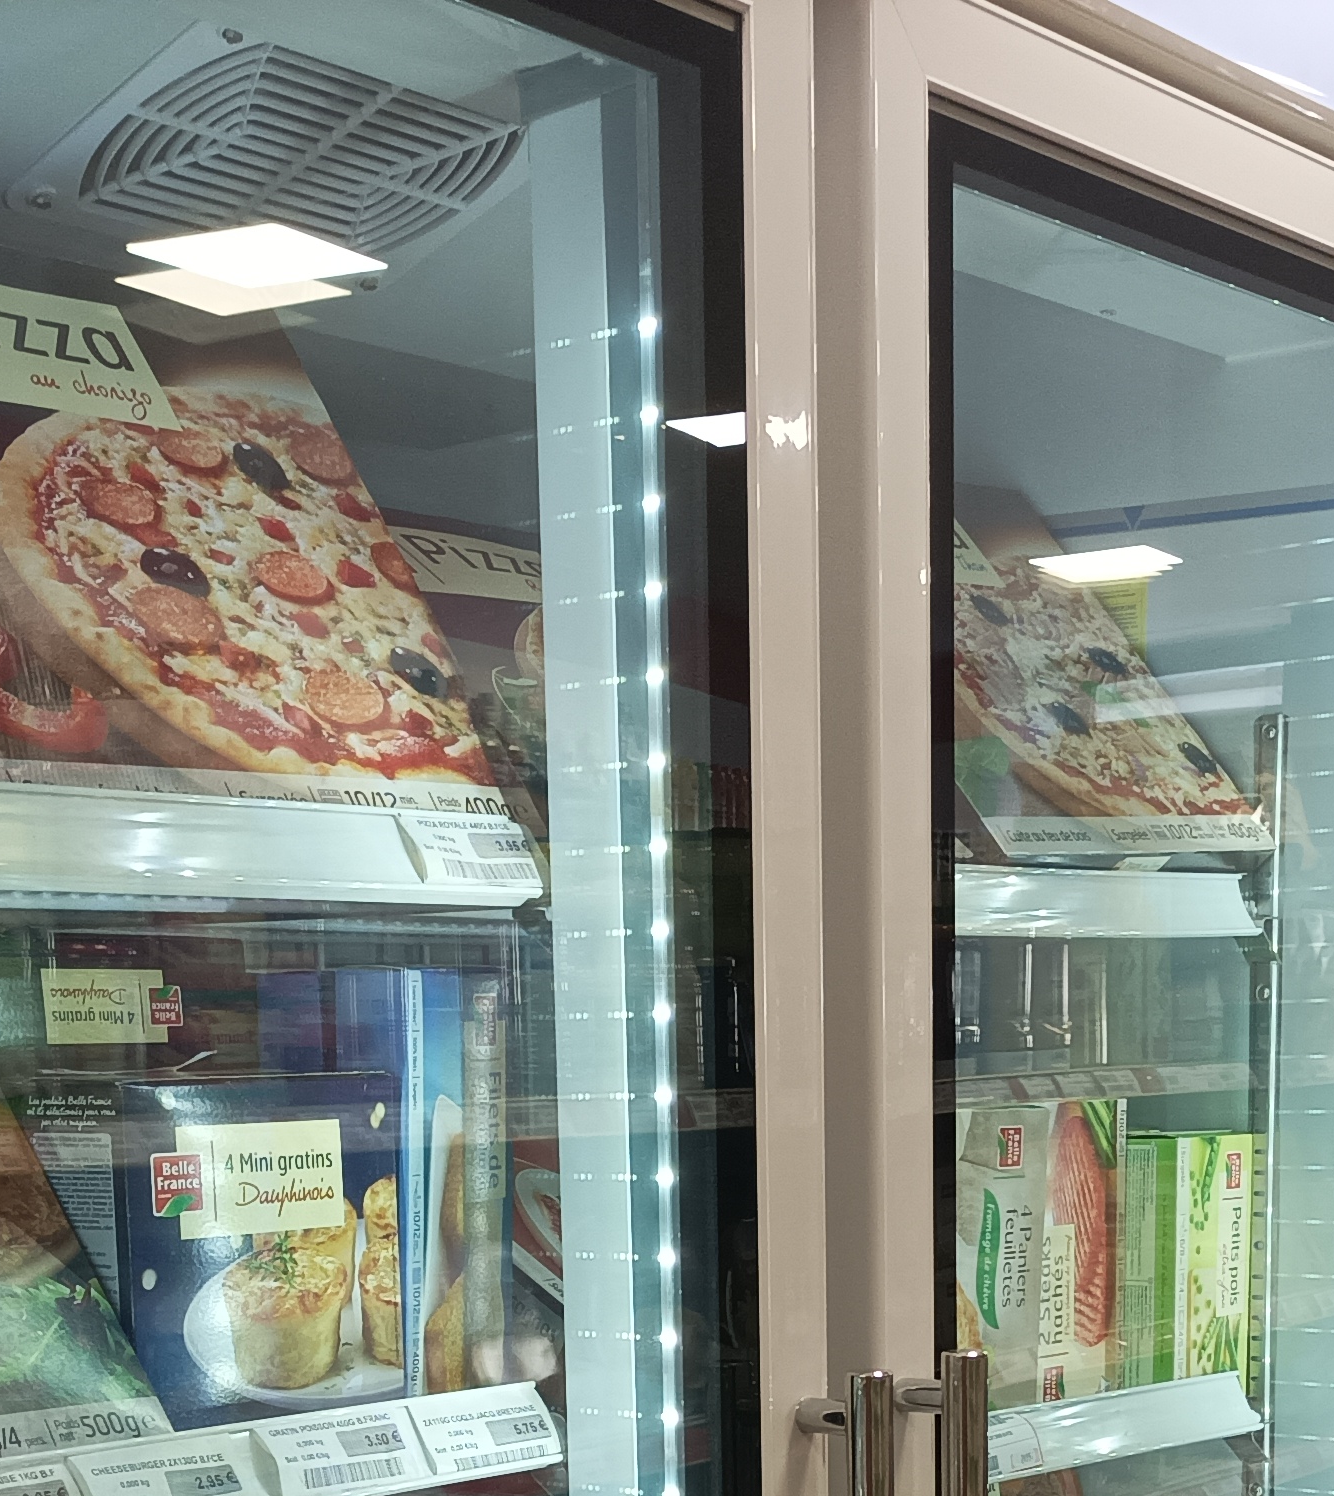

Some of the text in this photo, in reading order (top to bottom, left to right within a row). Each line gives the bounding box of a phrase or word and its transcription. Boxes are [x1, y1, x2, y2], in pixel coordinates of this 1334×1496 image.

[30, 372, 61, 391] au
[439, 820, 468, 830] ROYALE
[495, 839, 520, 852] 3,95
[52, 1007, 95, 1024] gratins
[99, 1011, 123, 1024] Mini
[161, 1161, 196, 1176] Belle
[225, 1149, 334, 1178] 4 Mini gratins
[156, 1175, 201, 1192] France
[235, 1181, 335, 1218] Dauphinois
[982, 1203, 994, 1310] Fromage de chèvre
[1001, 1208, 1018, 1308] feuilletés
[1016, 1205, 1033, 1308] 4 Paniers
[1228, 1206, 1242, 1306] Petits pois
[1039, 1236, 1051, 1321] Steaks
[1051, 1255, 1063, 1344] hachés
[80, 1411, 141, 1439] 500g
[268, 1425, 299, 1437] GRATIN
[513, 1420, 549, 1435] 5,75 €
[364, 1430, 402, 1447] 3,50 €
[18, 1471, 36, 1483] 1KG
[91, 1460, 166, 1477] CHEESEBURGER
[195, 1471, 239, 1490] 2,95 €
